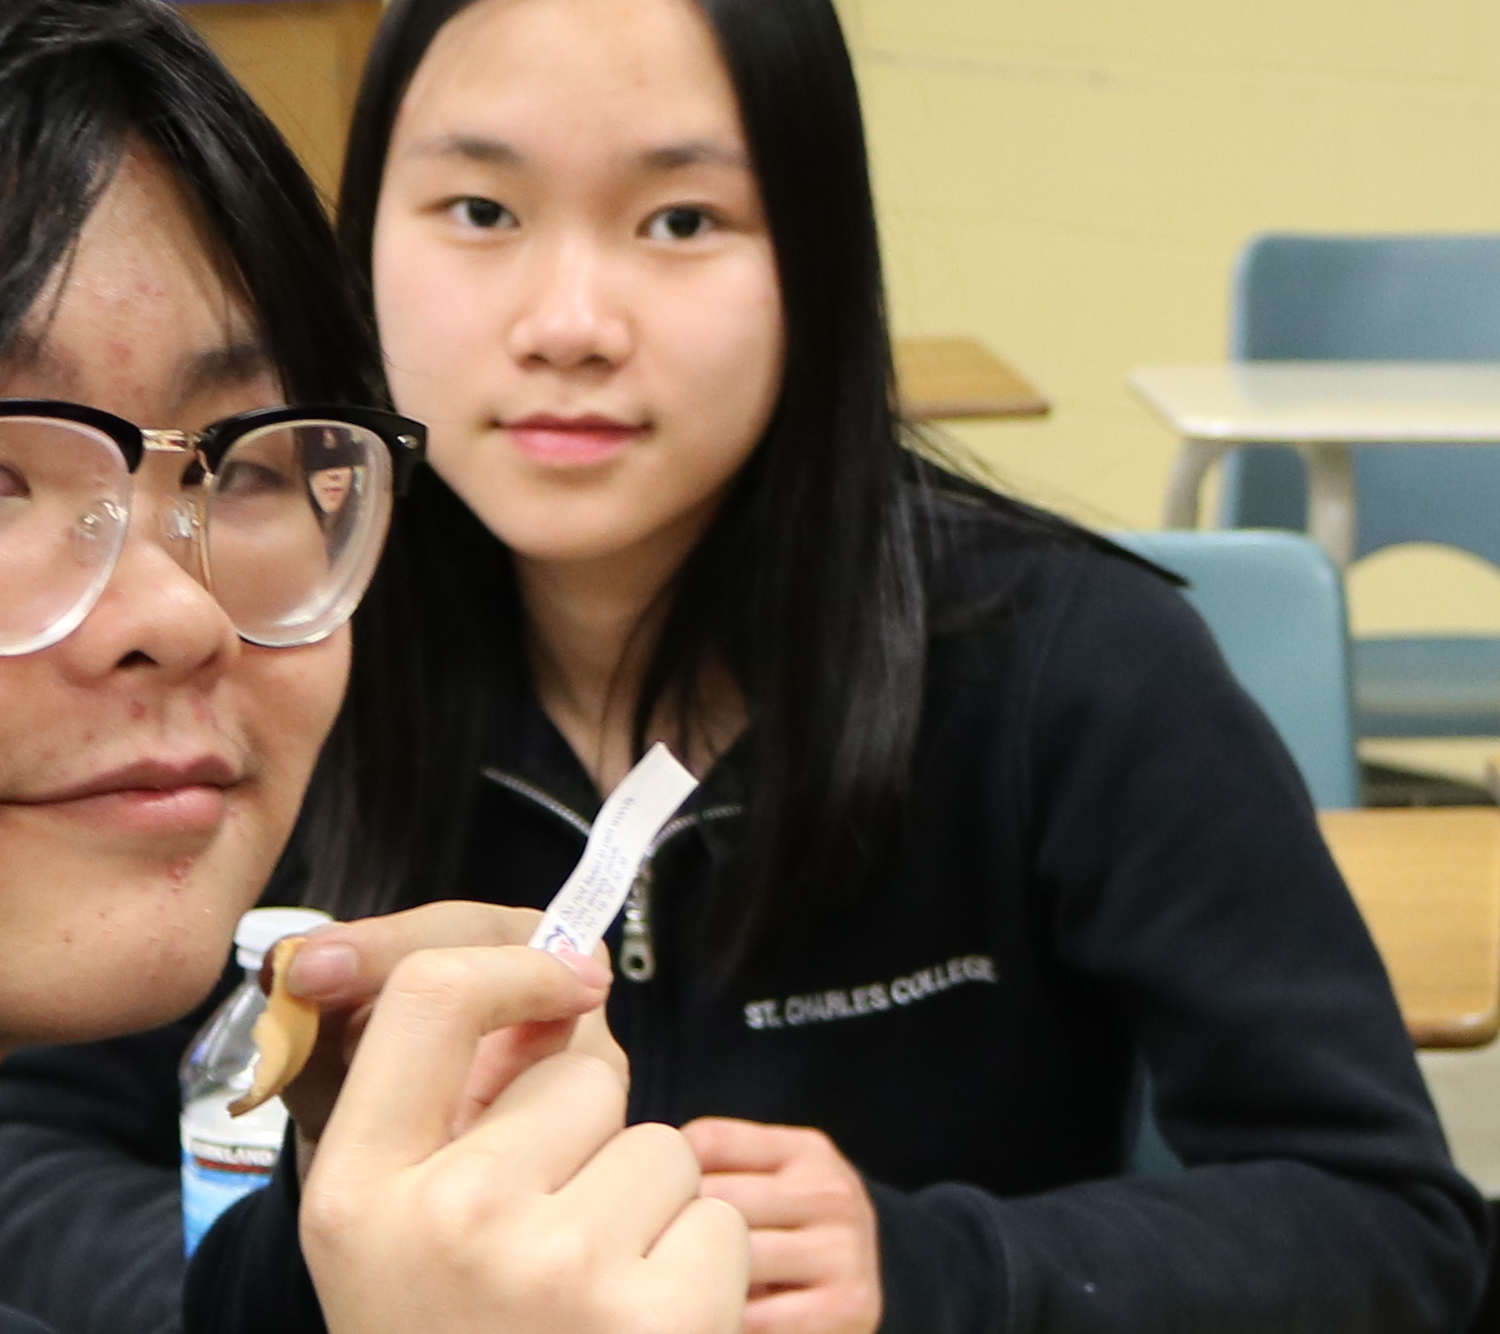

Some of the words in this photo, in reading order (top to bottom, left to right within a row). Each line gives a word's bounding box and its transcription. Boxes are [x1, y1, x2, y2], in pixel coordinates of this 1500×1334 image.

[743, 998, 784, 1031] ST.
[784, 982, 892, 1026] CHARLES
[890, 954, 998, 1006] COLLEGE
